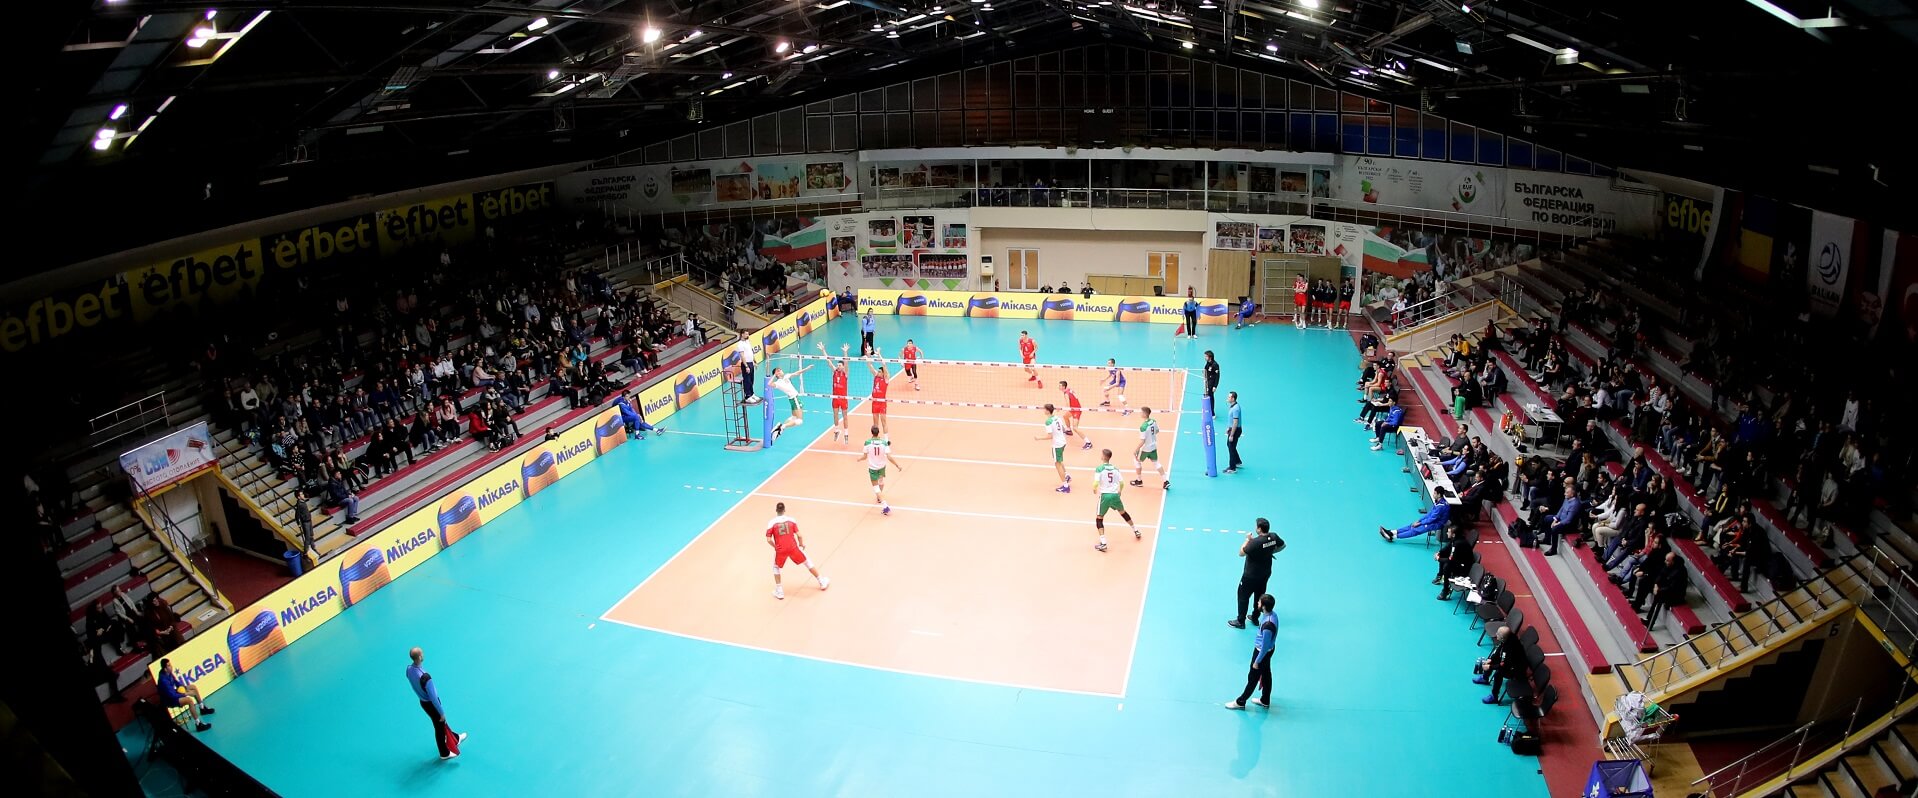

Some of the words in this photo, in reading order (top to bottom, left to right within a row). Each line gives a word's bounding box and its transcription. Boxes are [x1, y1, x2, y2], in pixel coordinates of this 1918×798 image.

[481, 183, 551, 221] efbet
[1514, 182, 1583, 199] БЪЛГАРСКА
[1523, 197, 1594, 214] ФЕДЕРАЦИЯ
[387, 198, 468, 242] efbet
[1532, 211, 1549, 223] ПО
[1667, 199, 1713, 238] efbe
[273, 216, 372, 270] efbet
[143, 244, 253, 305] efbet
[0, 278, 124, 352] efbet
[1152, 304, 1184, 315] MIKAS
[873, 446, 880, 456] 11
[1107, 472, 1114, 484] 5
[177, 652, 226, 686] IKASA
